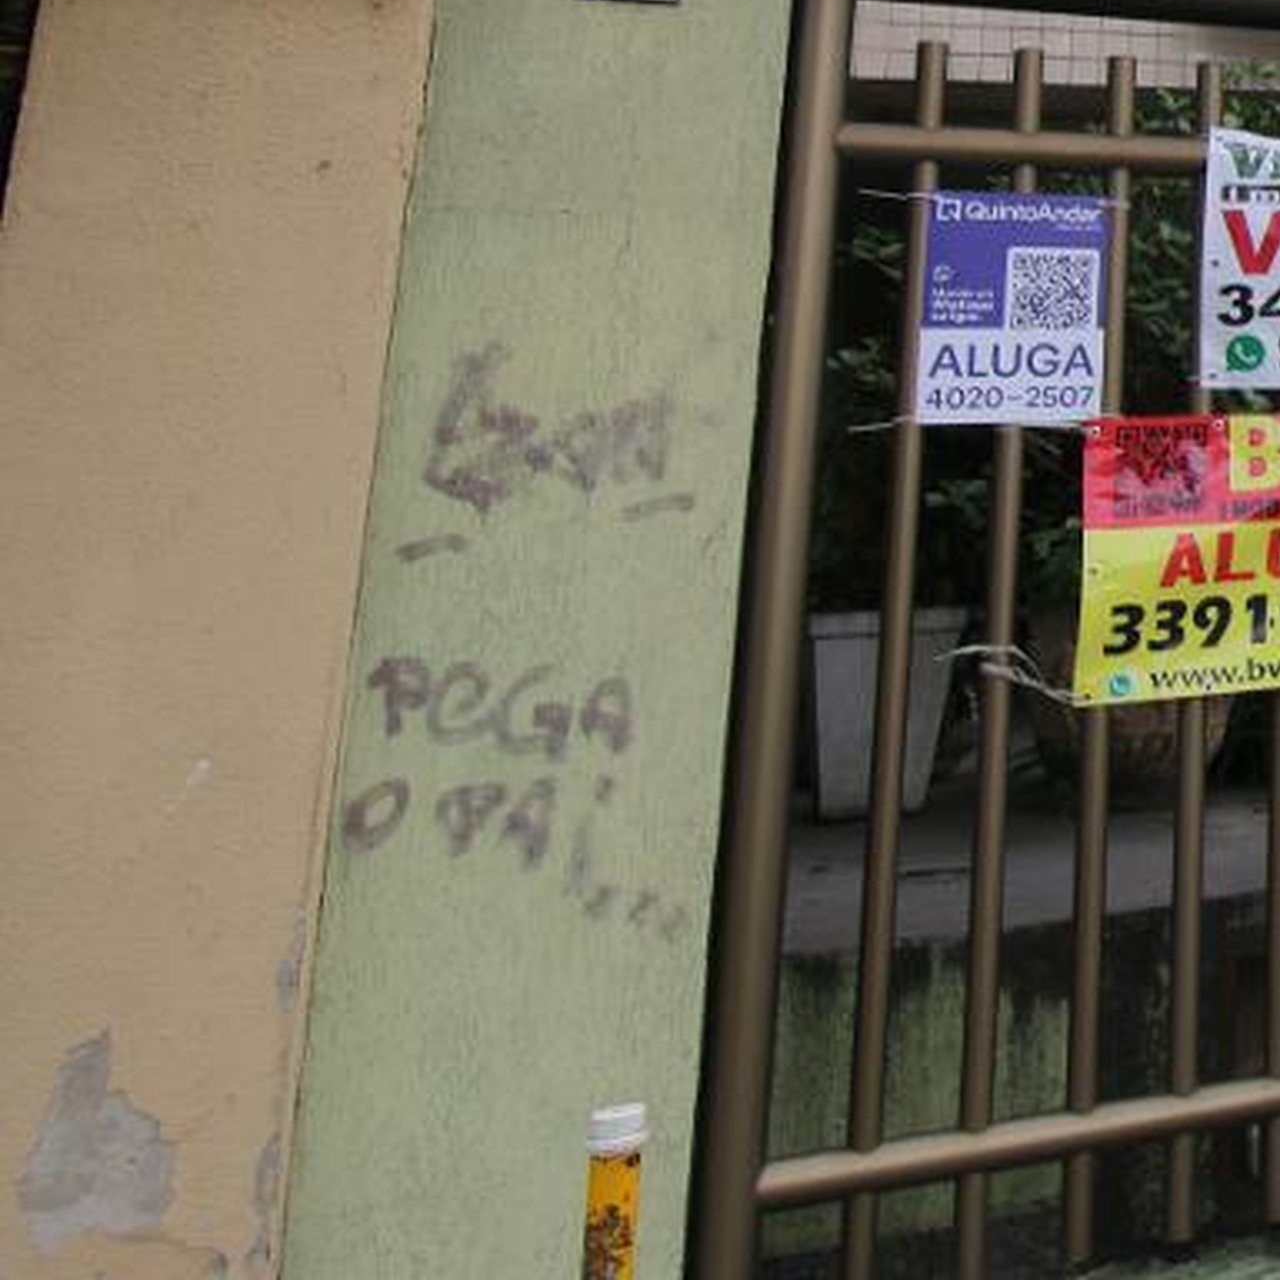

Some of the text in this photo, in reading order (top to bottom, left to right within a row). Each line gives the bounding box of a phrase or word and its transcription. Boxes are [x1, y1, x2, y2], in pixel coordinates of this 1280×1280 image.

[965, 201, 1102, 222] QuintoAndar
[928, 343, 1094, 378] ALUGA
[925, 386, 1095, 410] 4020-2507
